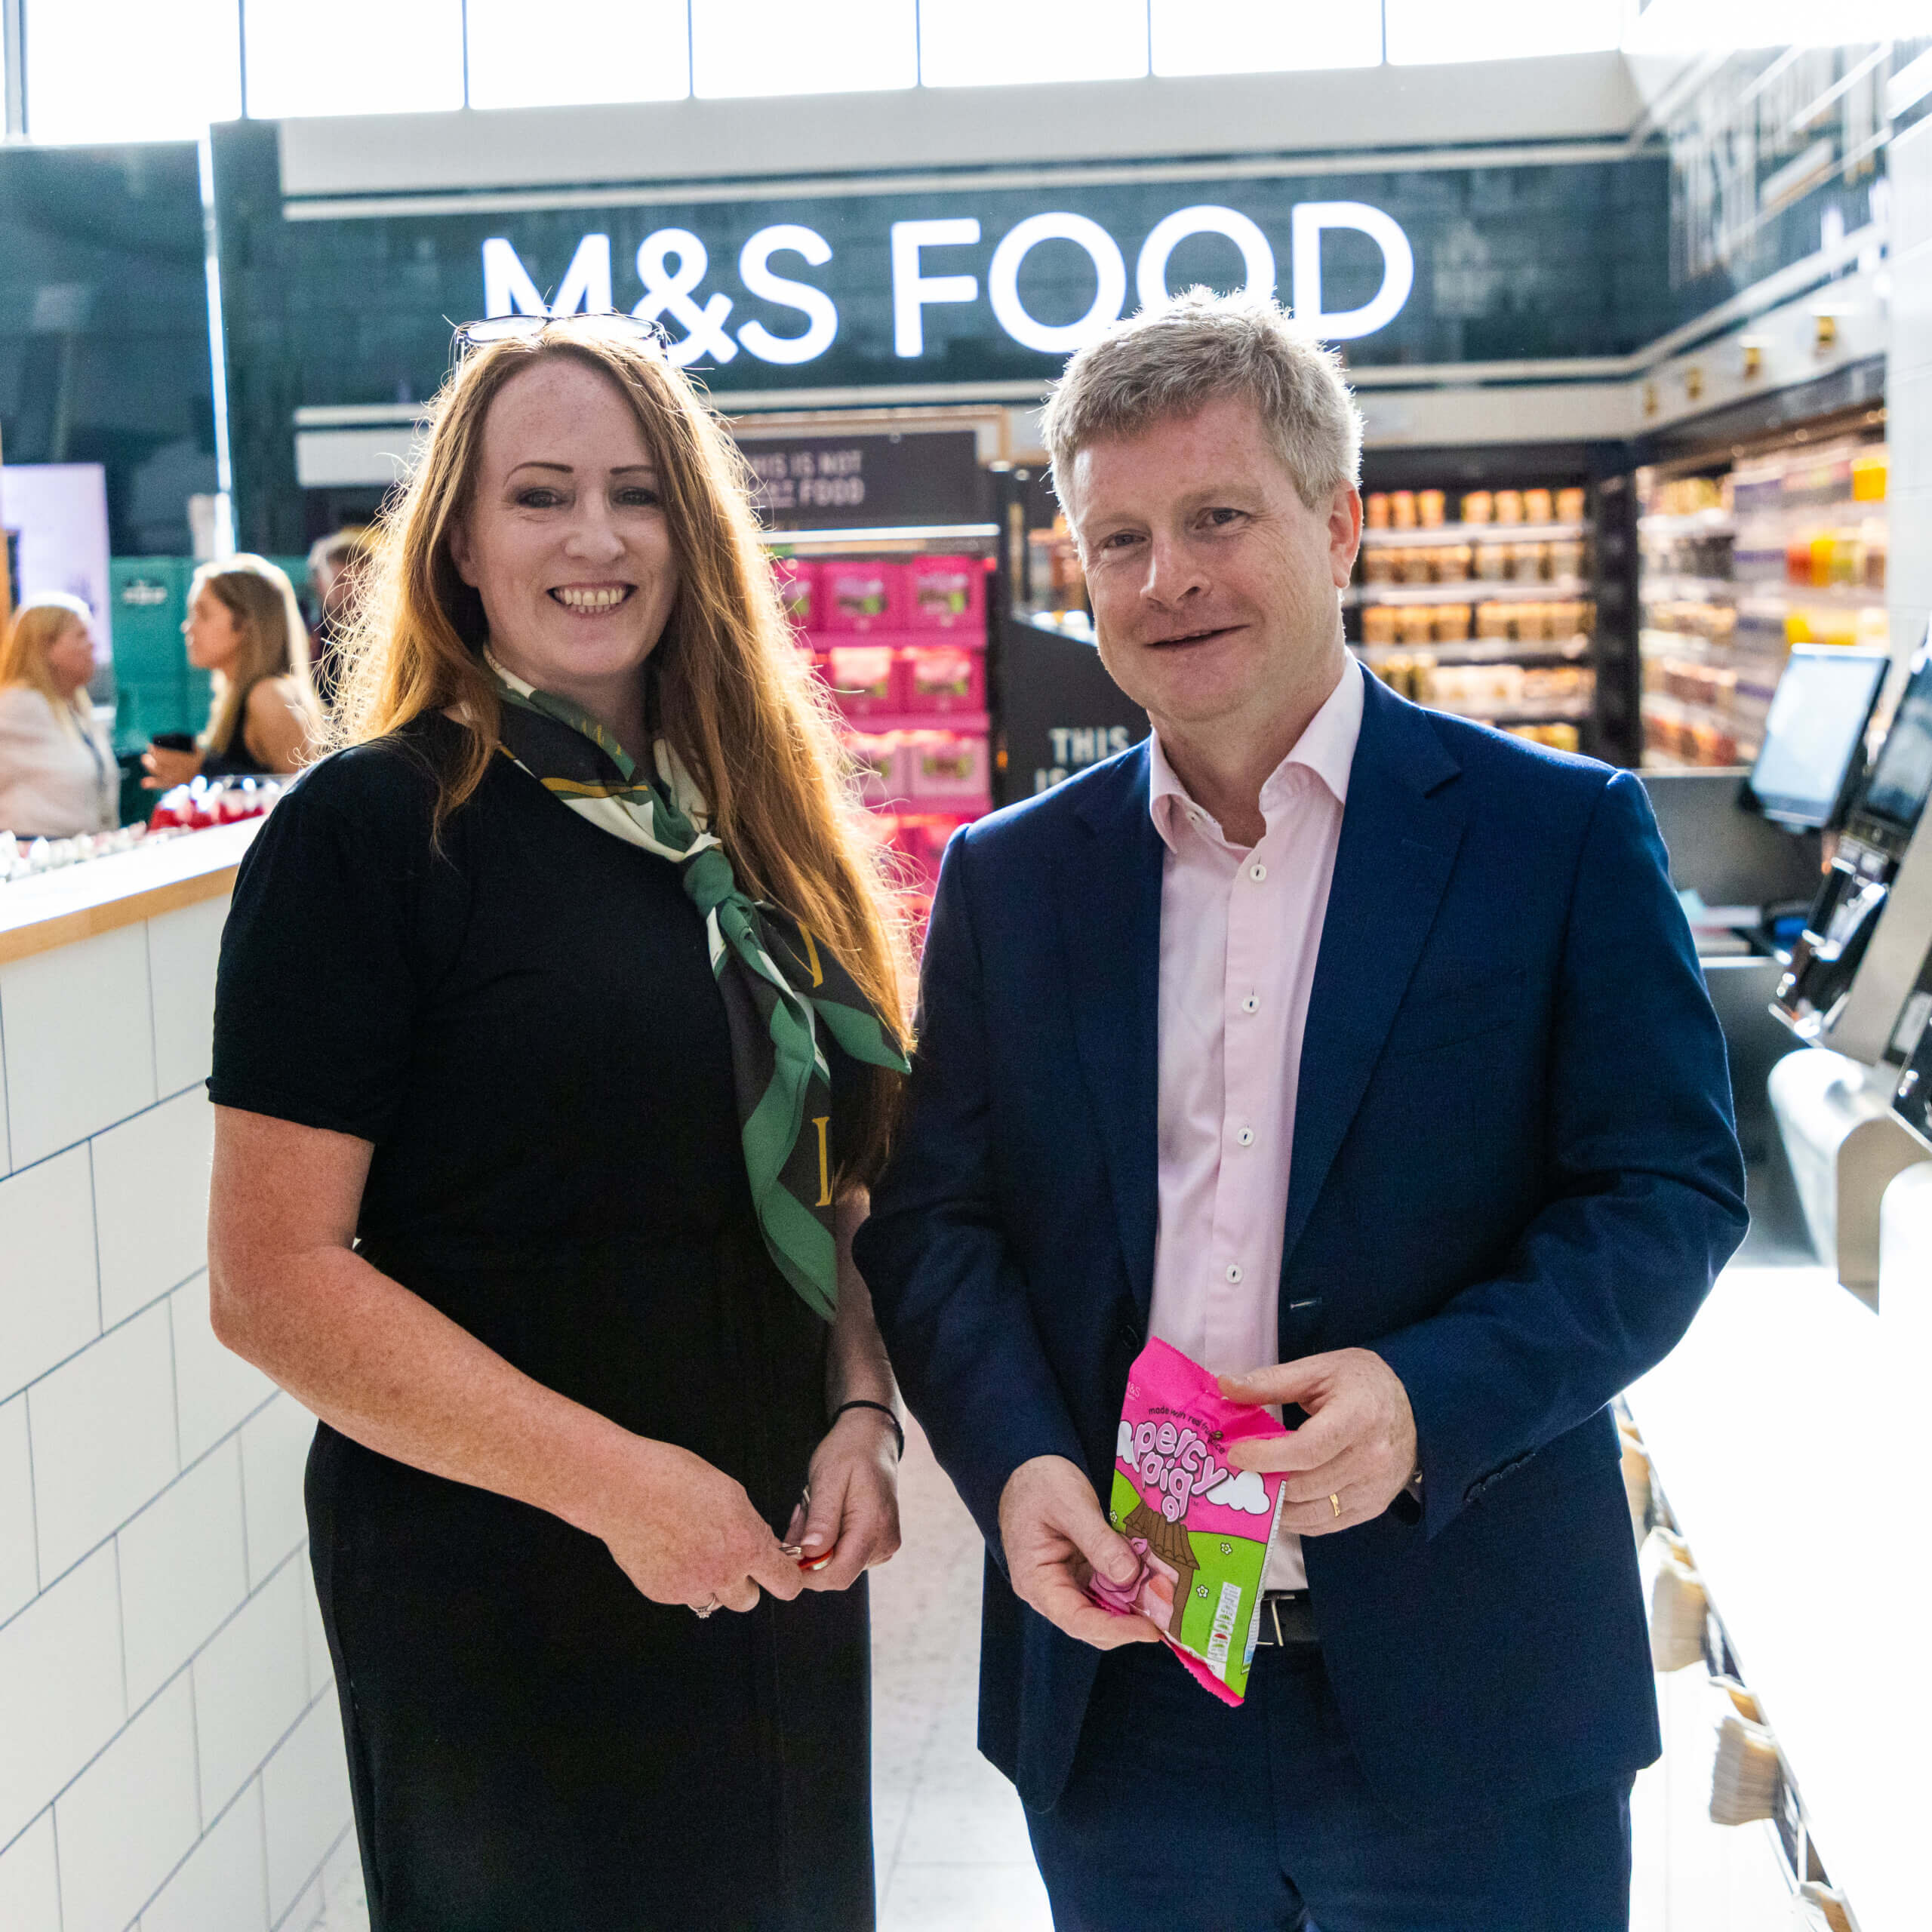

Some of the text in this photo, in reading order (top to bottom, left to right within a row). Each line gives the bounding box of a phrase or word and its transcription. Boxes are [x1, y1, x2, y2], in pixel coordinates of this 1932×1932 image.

[482, 201, 1414, 368] M&S FOOD
[798, 478, 865, 506] FOOD
[1048, 726, 1130, 764] THIS
[1149, 1406, 1170, 1415] made
[1188, 1416, 1202, 1426] real
[1134, 1420, 1229, 1496] percy
[1141, 1451, 1194, 1523] pig
